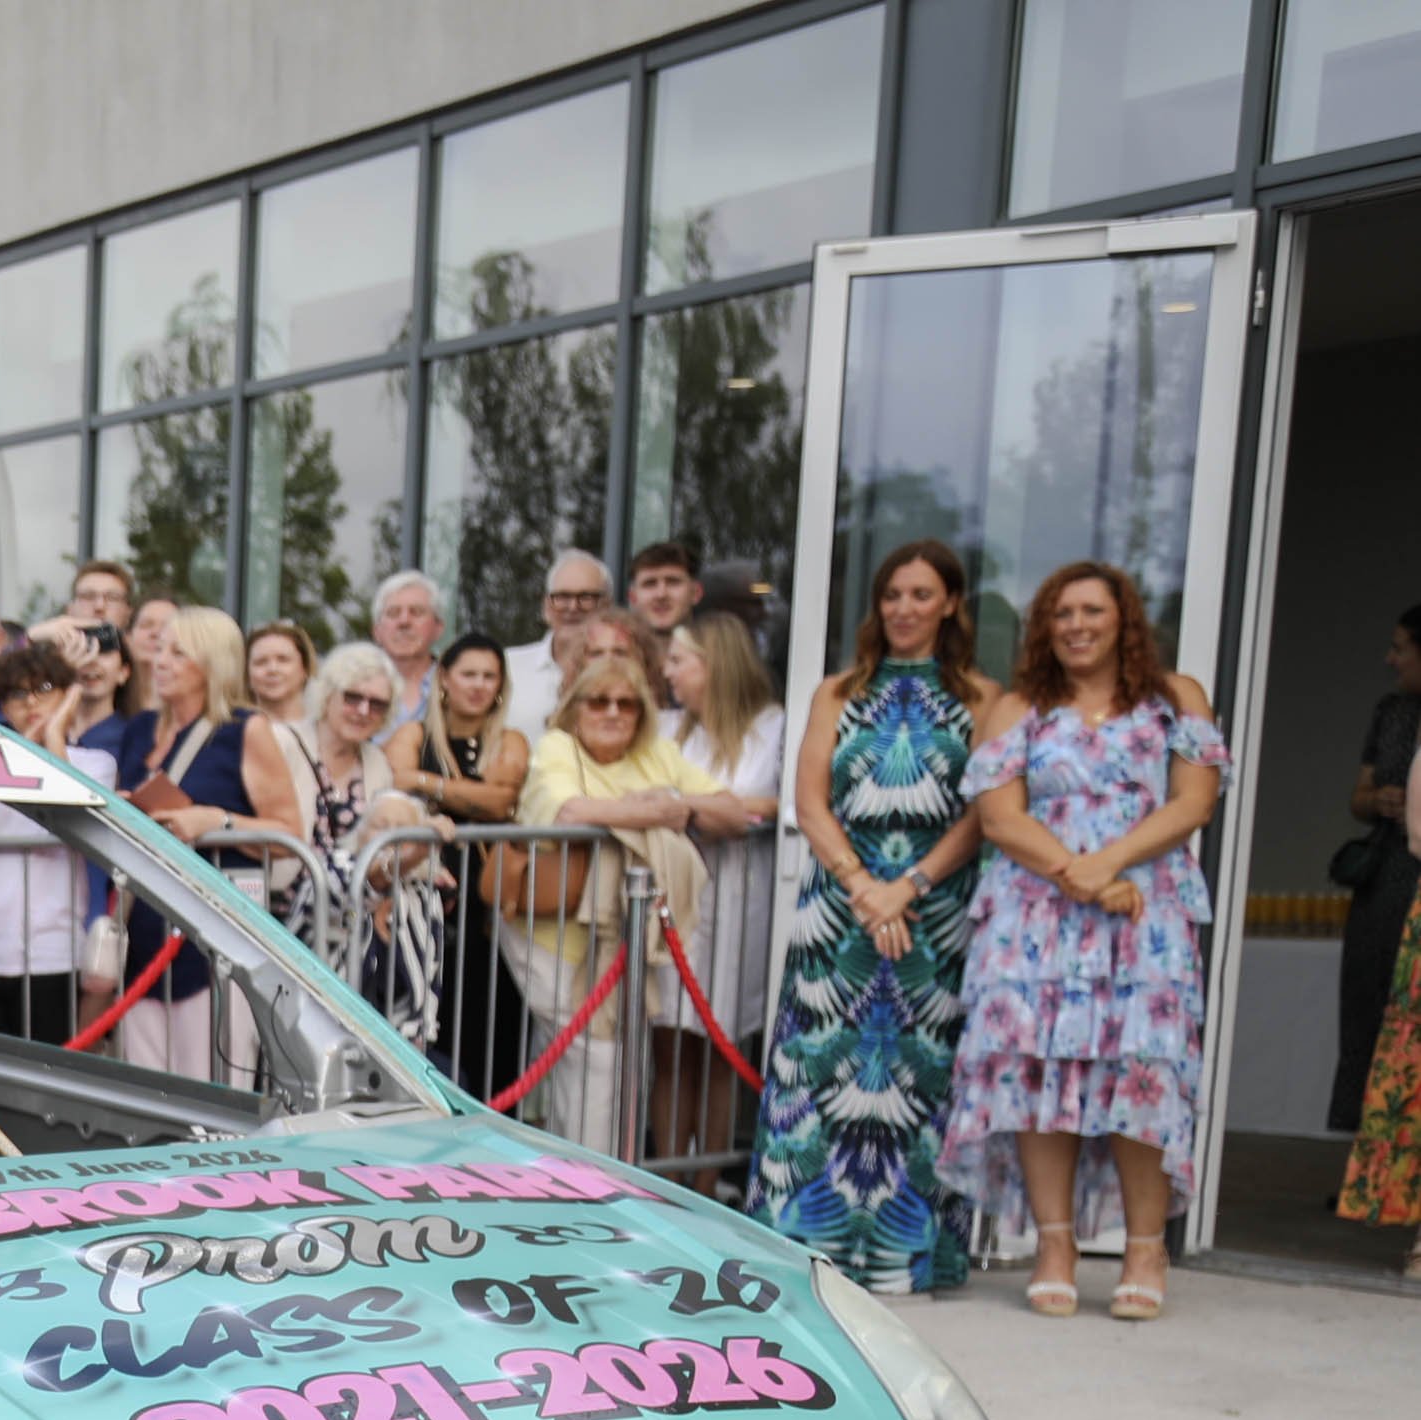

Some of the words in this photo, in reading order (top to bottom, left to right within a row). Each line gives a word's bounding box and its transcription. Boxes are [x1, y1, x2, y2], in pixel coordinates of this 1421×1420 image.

[67, 1158, 171, 1178] June
[171, 1149, 283, 1169] 2026
[333, 1154, 671, 1204] PARK
[75, 1214, 486, 1314] Prom
[21, 1286, 421, 1392] CLASS
[452, 1273, 600, 1325] OF
